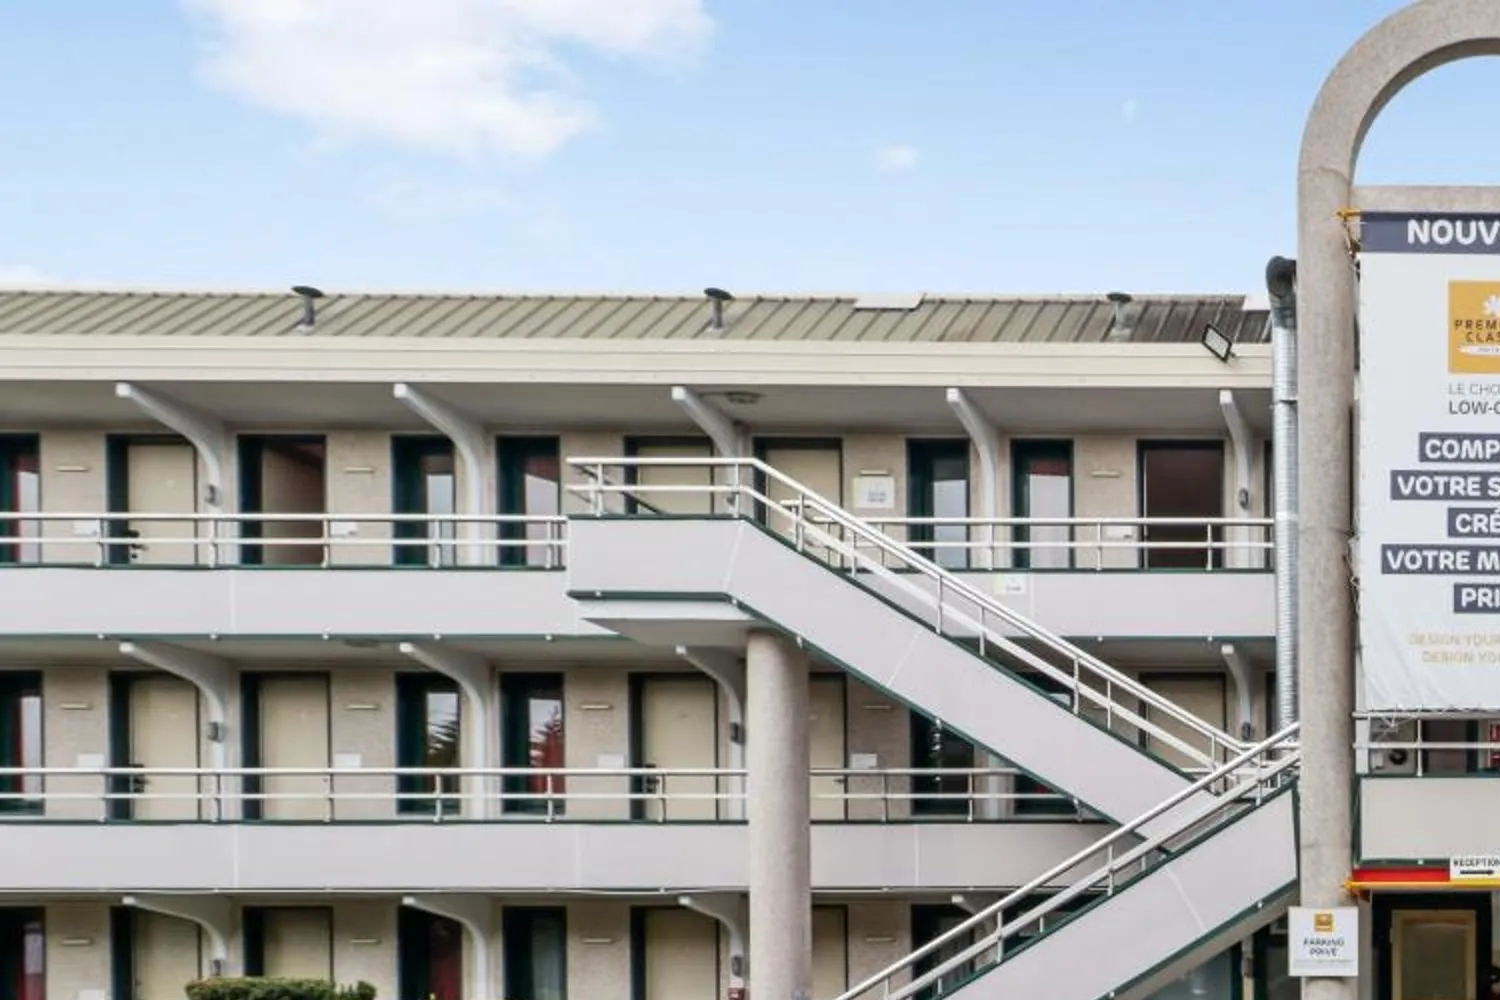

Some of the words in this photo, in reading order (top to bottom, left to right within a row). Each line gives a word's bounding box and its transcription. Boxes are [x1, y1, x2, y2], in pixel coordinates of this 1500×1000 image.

[1448, 383, 1465, 395] LE
[1397, 475, 1481, 497] VOTRE
[1386, 551, 1471, 571] VOTRE
